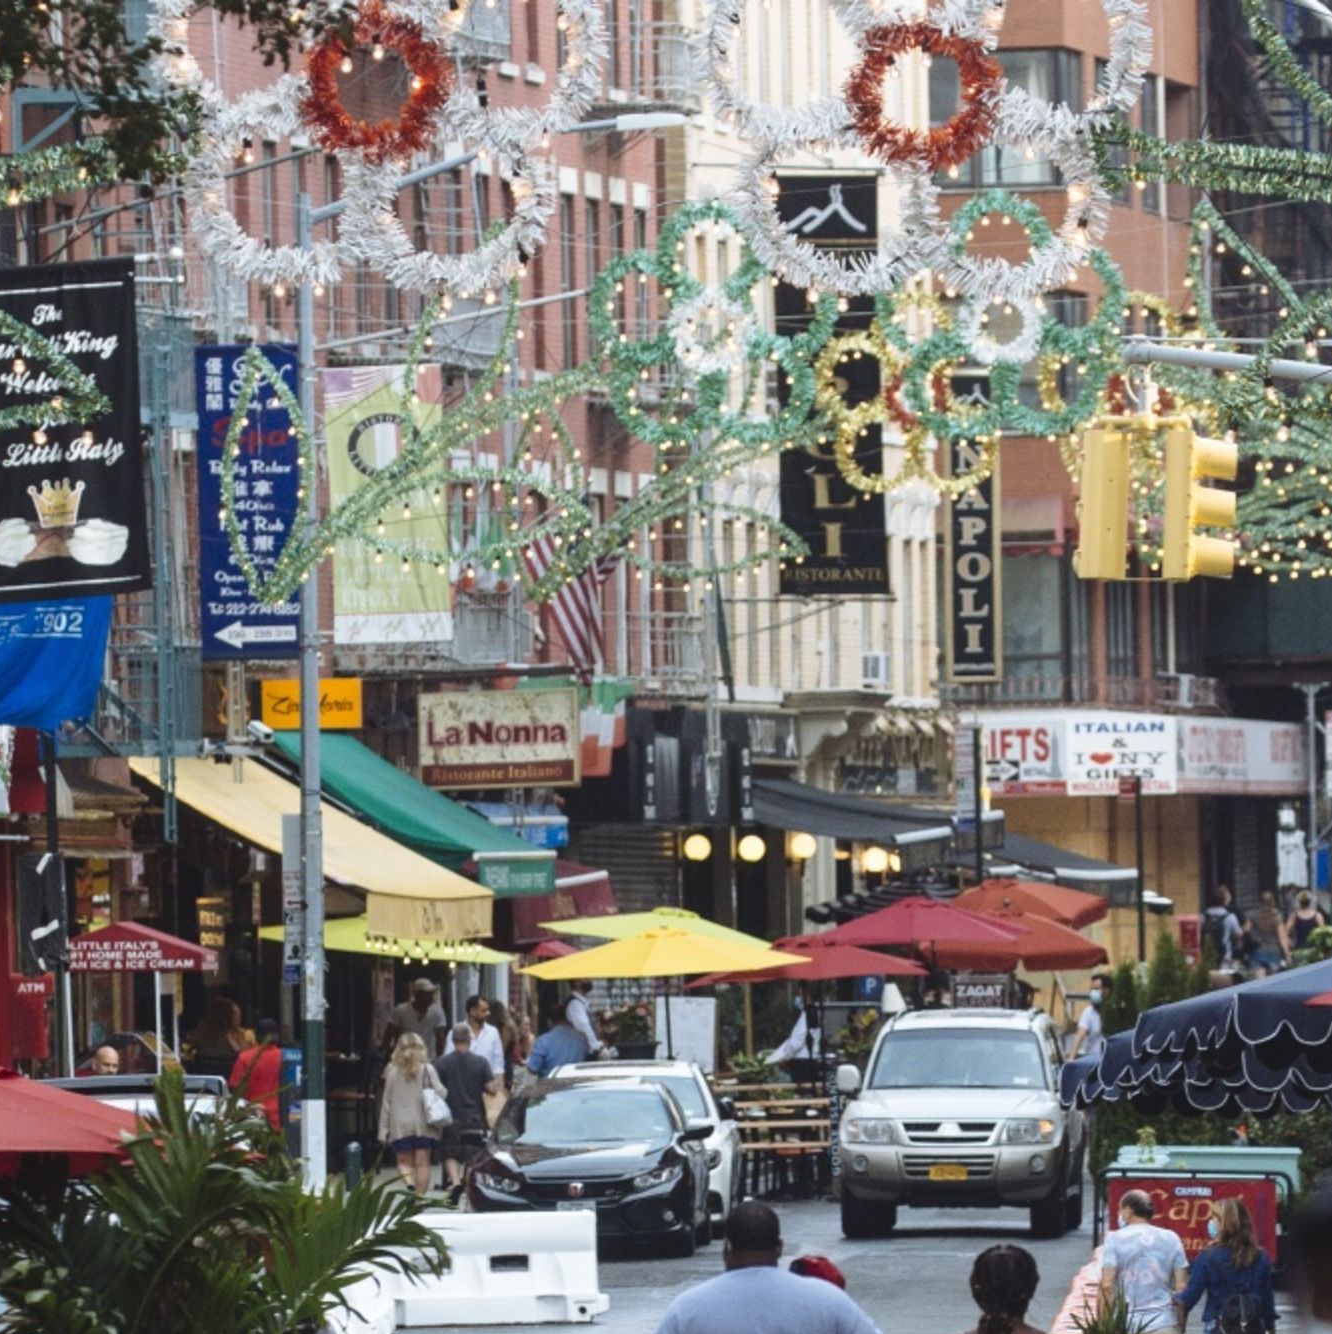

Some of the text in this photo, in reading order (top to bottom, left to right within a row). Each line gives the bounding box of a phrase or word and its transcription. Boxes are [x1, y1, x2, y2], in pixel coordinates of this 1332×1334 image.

[63, 329, 119, 360] King
[65, 437, 125, 467] Italy
[250, 459, 292, 474] Relax
[252, 515, 285, 532] Rub
[783, 564, 885, 583] RISTORANTE
[426, 718, 567, 747] La Nonna
[1074, 722, 1165, 733] ITALIAN
[1113, 737, 1128, 748] &
[1075, 752, 1167, 765] I NY
[431, 764, 563, 781] Ristorante Italiano
[69, 940, 160, 950] LITTLE ITALY'S
[86, 950, 124, 960] HOME
[125, 950, 163, 960] MADE
[89, 960, 112, 970] ICE
[113, 960, 124, 969] &
[125, 960, 147, 969] ICE
[149, 958, 196, 969] CREAM
[17, 982, 46, 993] ATM
[955, 984, 1005, 997] ZAGAT
